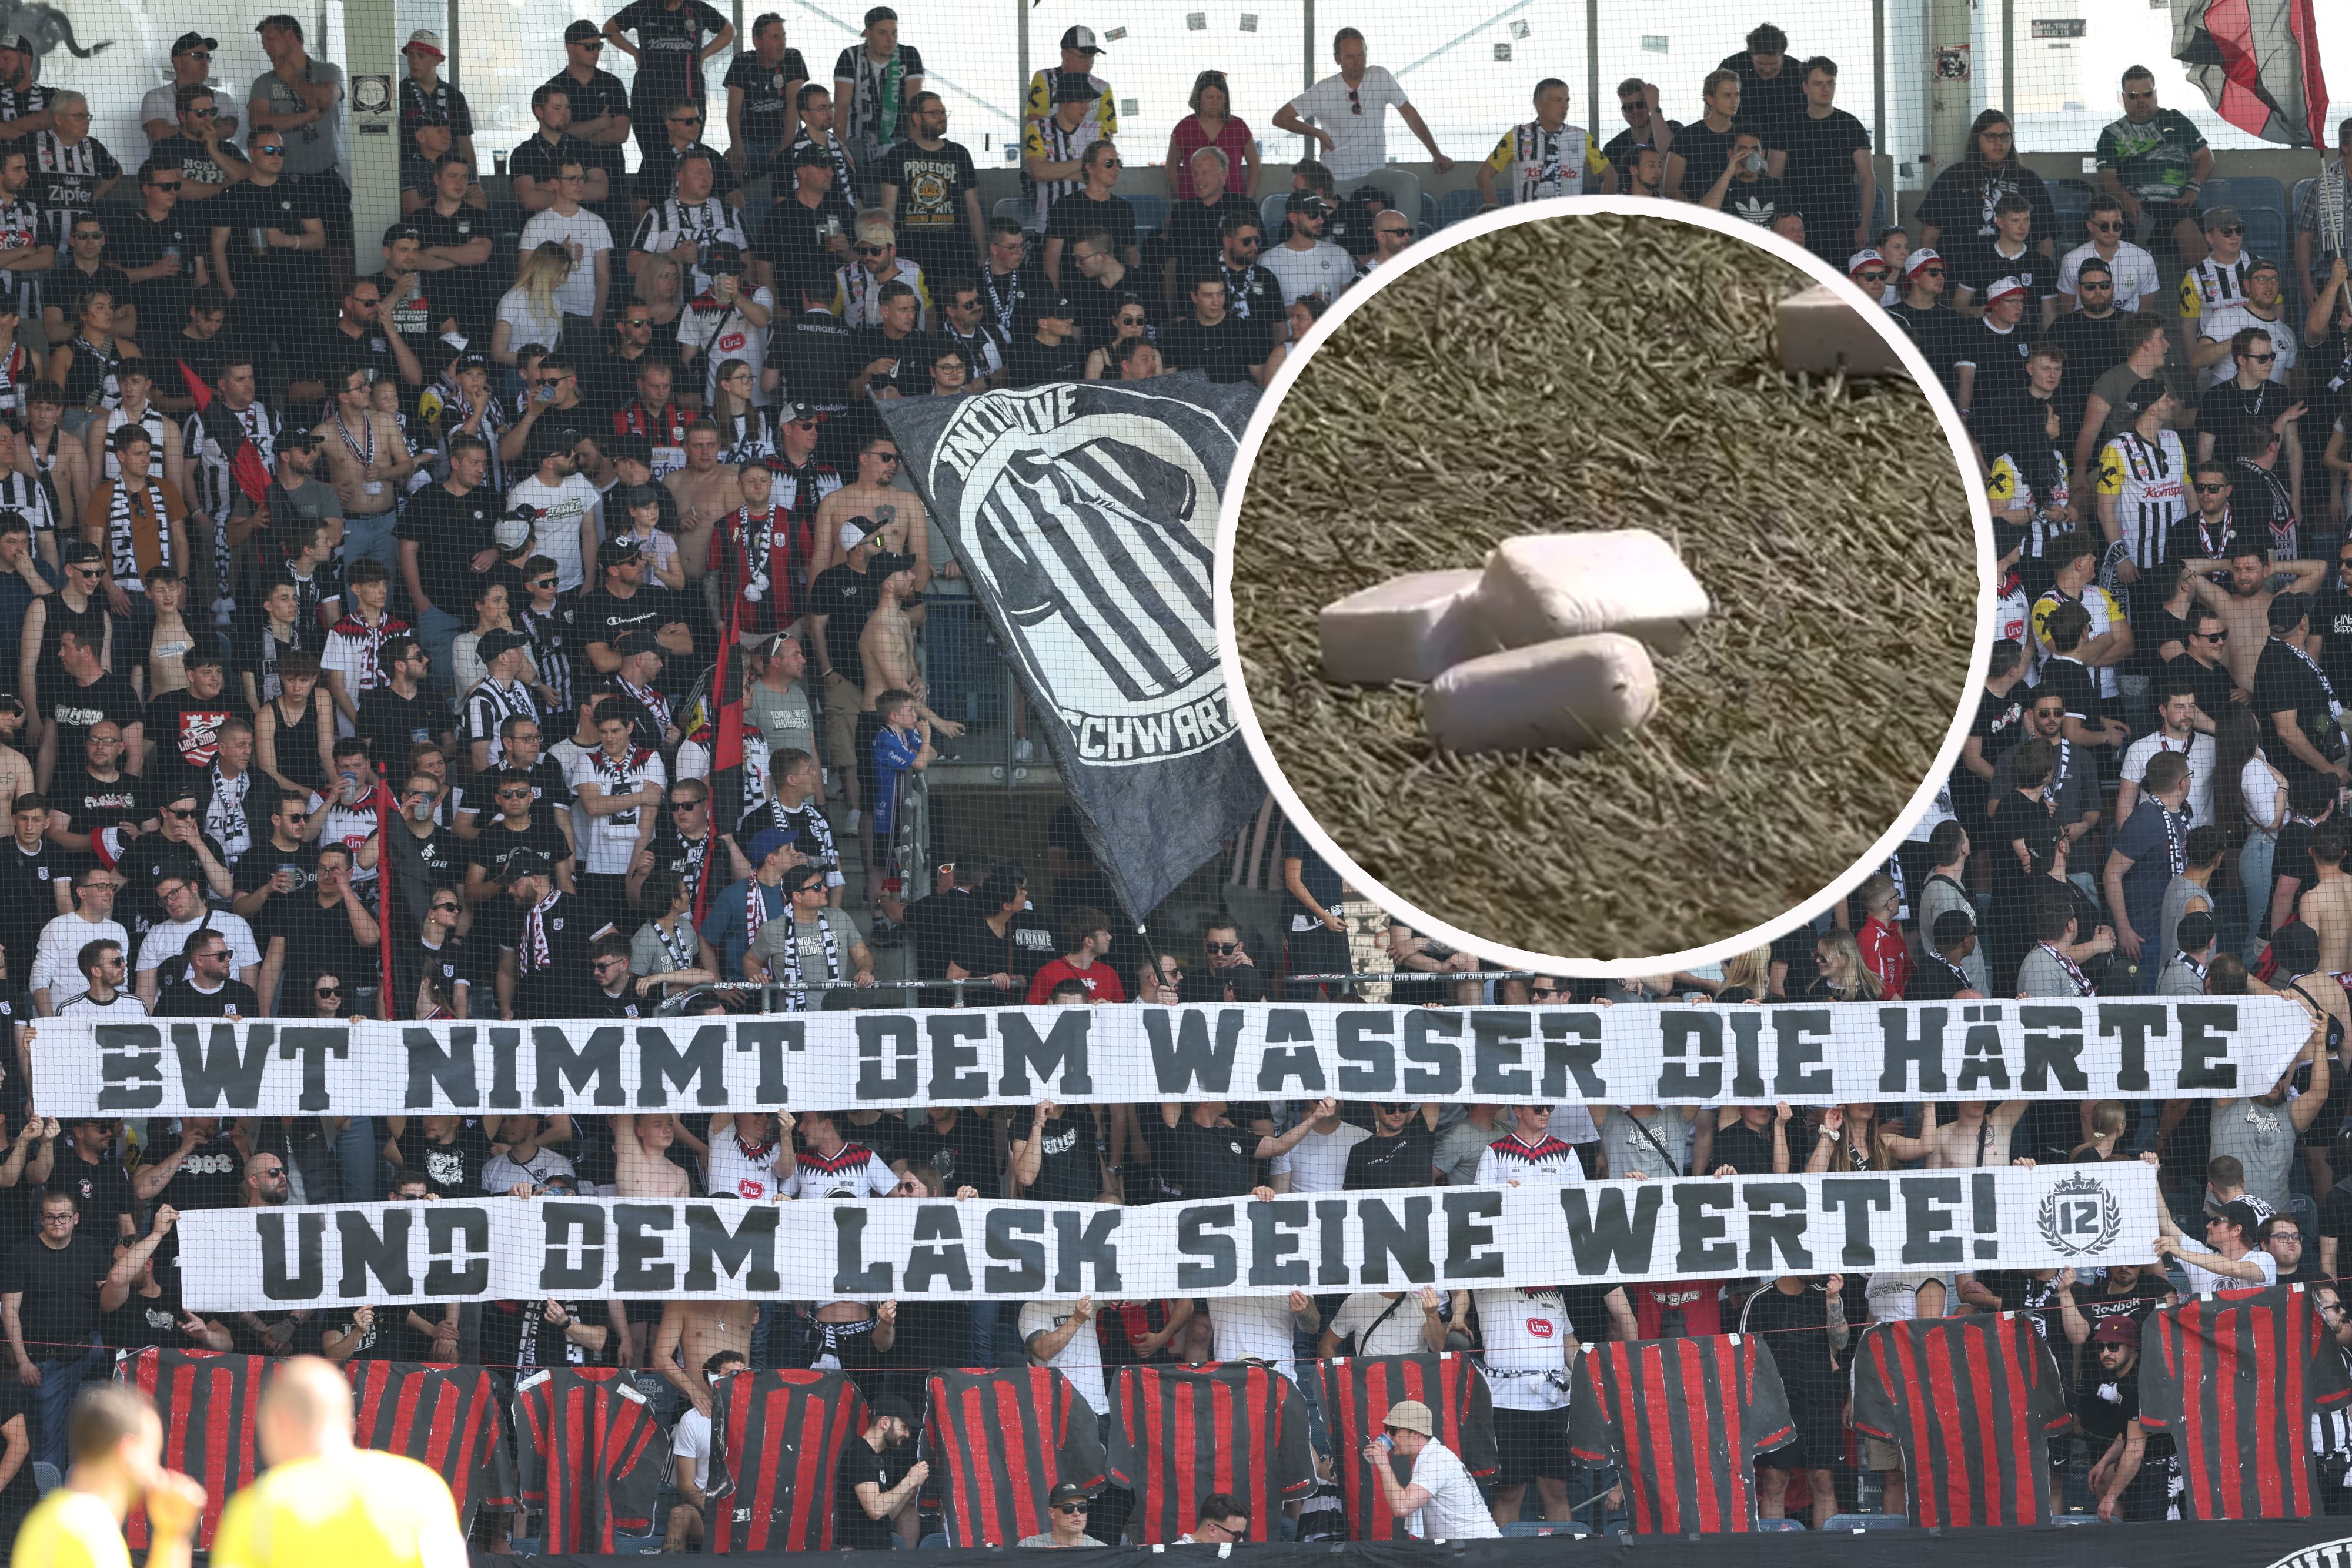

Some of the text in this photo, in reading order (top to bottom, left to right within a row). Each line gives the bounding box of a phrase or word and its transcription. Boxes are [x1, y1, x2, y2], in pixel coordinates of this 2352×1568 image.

[723, 337, 741, 349] Linz
[606, 611, 657, 626] Champion
[2007, 623, 2023, 636] Linz
[1393, 974, 1407, 982] CITY
[1409, 973, 1431, 981] GROUP
[1482, 972, 1505, 980] GROUP
[95, 1003, 2238, 1111] BWT NIMMT DEM WASSER DIE HÄRTE
[741, 1181, 760, 1196] inz
[256, 1172, 2099, 1300] UND DEM LASK SEINE WERTE! 12
[1531, 1321, 1551, 1334] Linz
